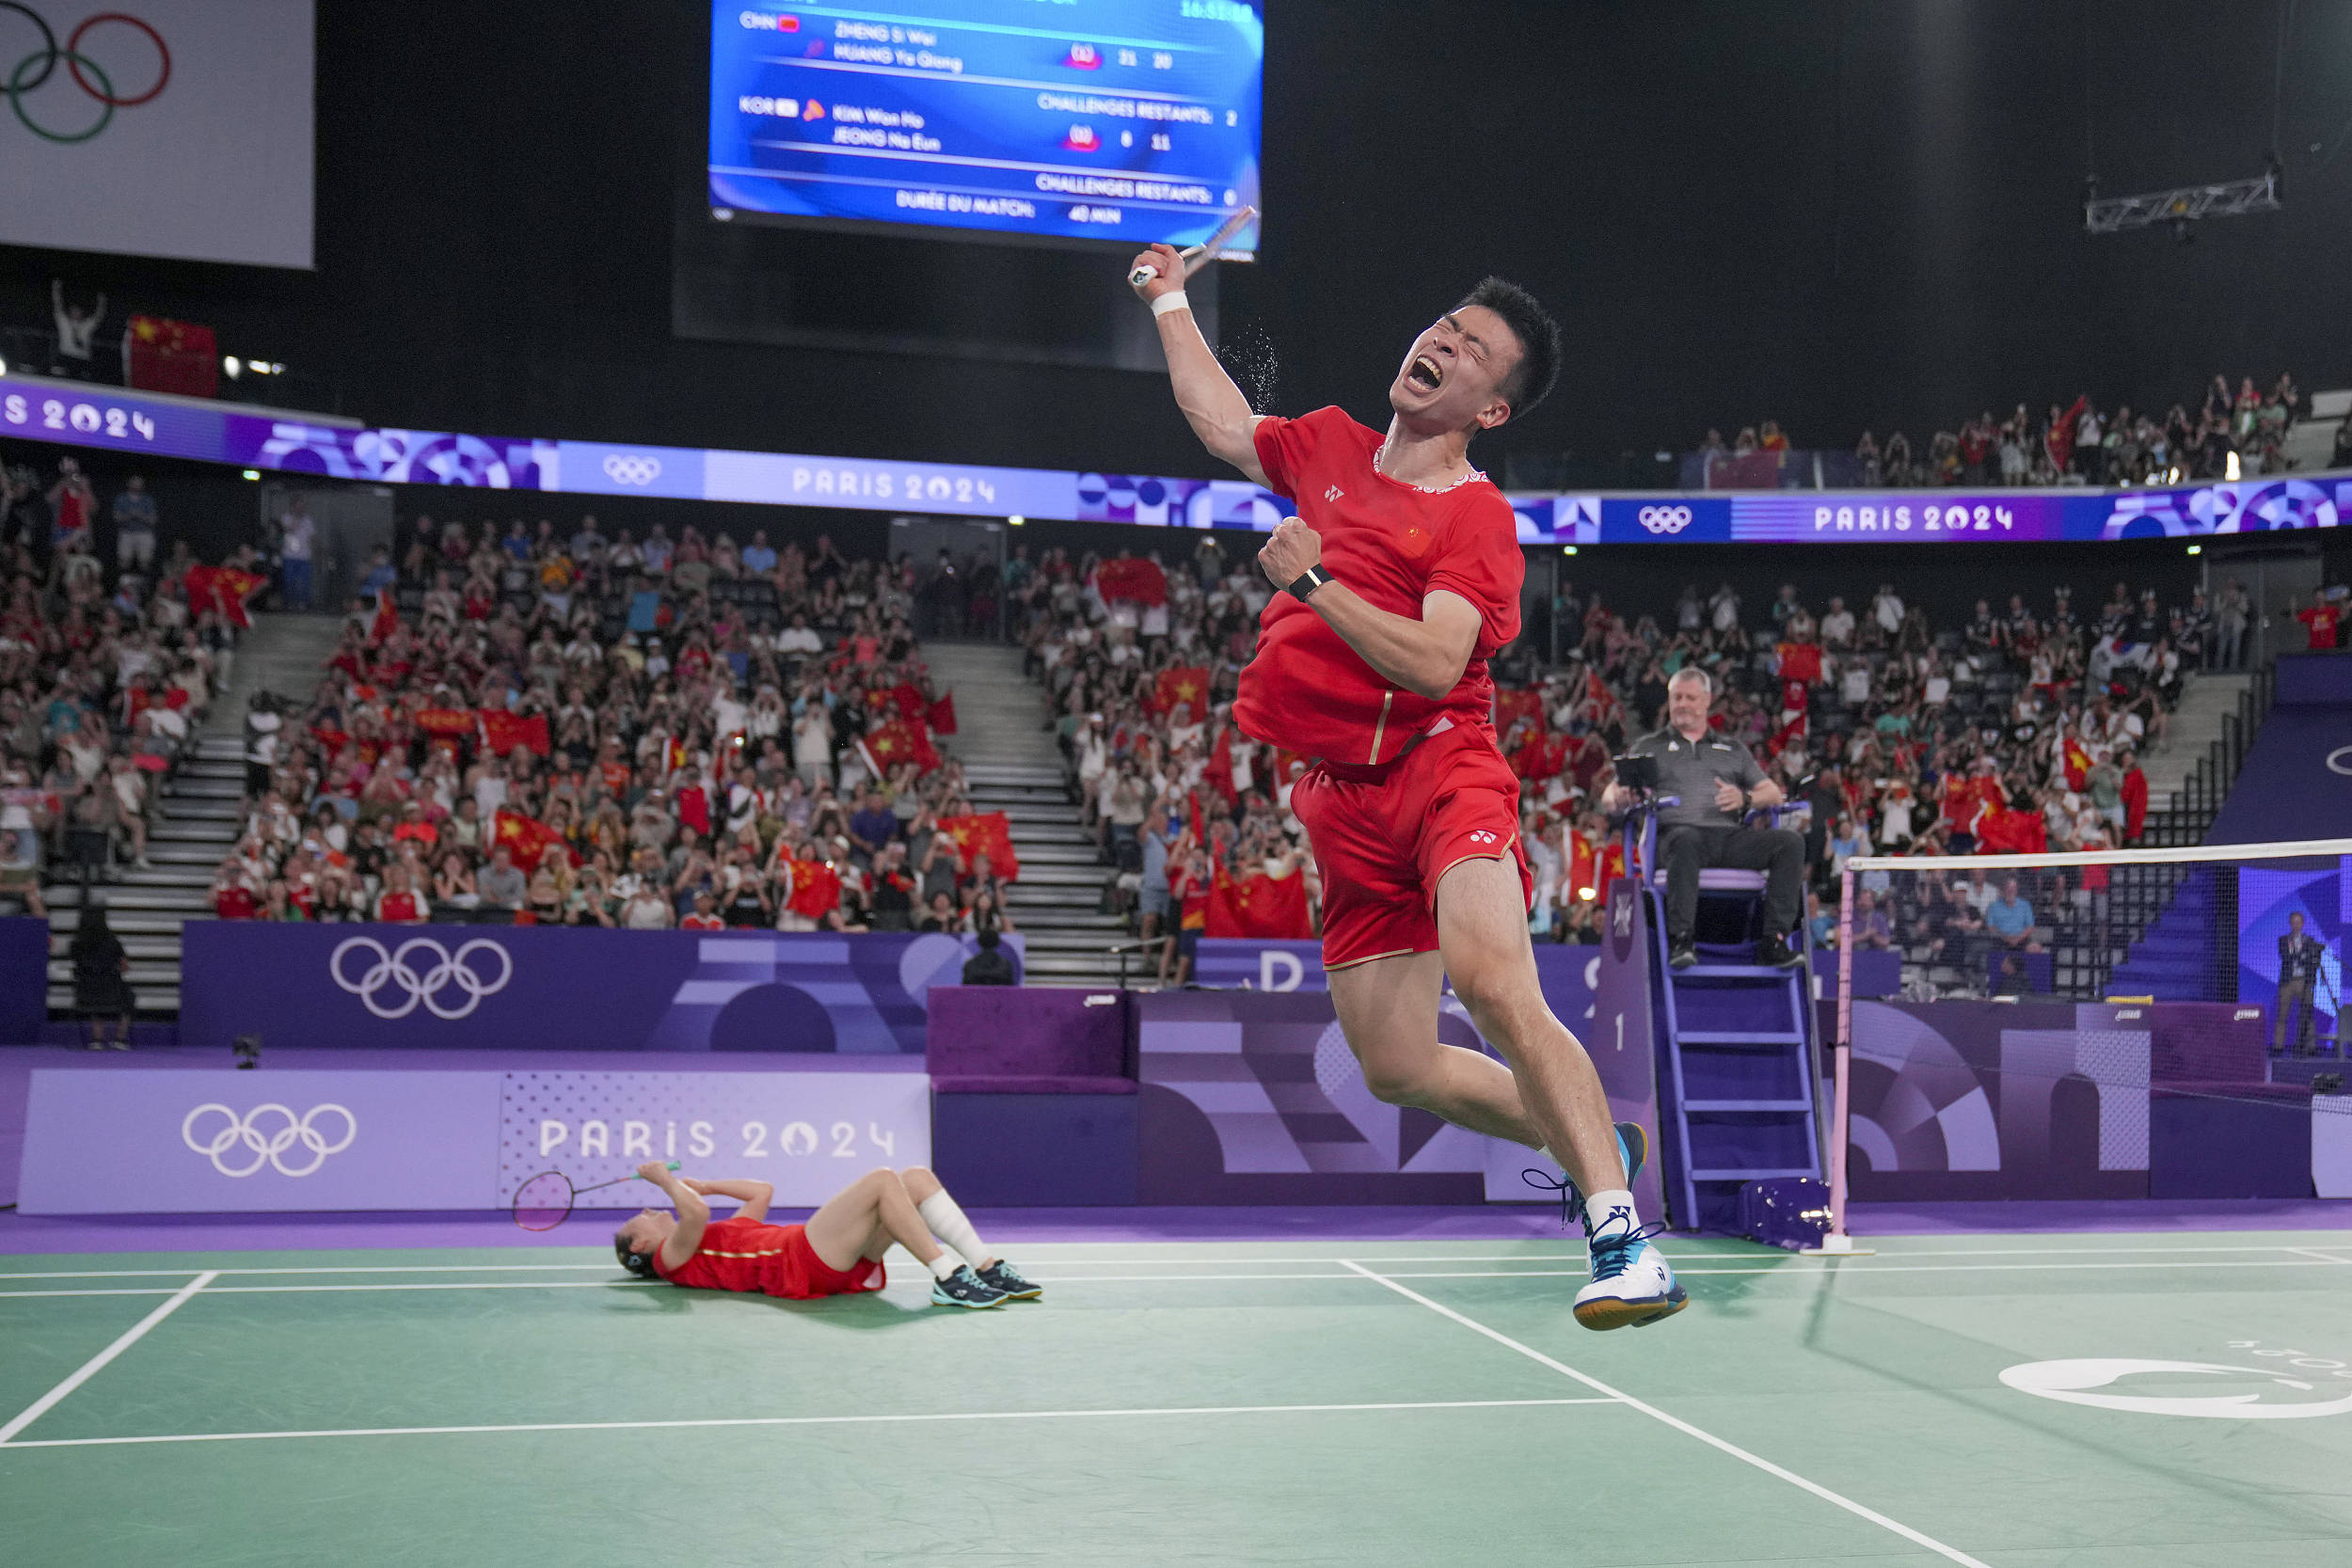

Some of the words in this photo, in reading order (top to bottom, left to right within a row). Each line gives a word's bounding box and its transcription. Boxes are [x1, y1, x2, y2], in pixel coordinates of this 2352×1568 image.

[739, 10, 777, 30] CHN
[834, 20, 890, 42] ZHENG
[834, 41, 894, 65] HUANG
[739, 95, 775, 115] KOR
[1037, 92, 1136, 118] CHALLENGES
[834, 126, 888, 147] JEONG
[1035, 173, 1134, 198] CHALLENGES
[896, 188, 946, 212] DURÉE
[947, 194, 972, 214] DU
[1089, 208, 1121, 224] MIN
[42, 399, 154, 441] 2024
[905, 474, 995, 504] 2024
[1924, 505, 2013, 531] 2024
[741, 1120, 895, 1158] 2024
